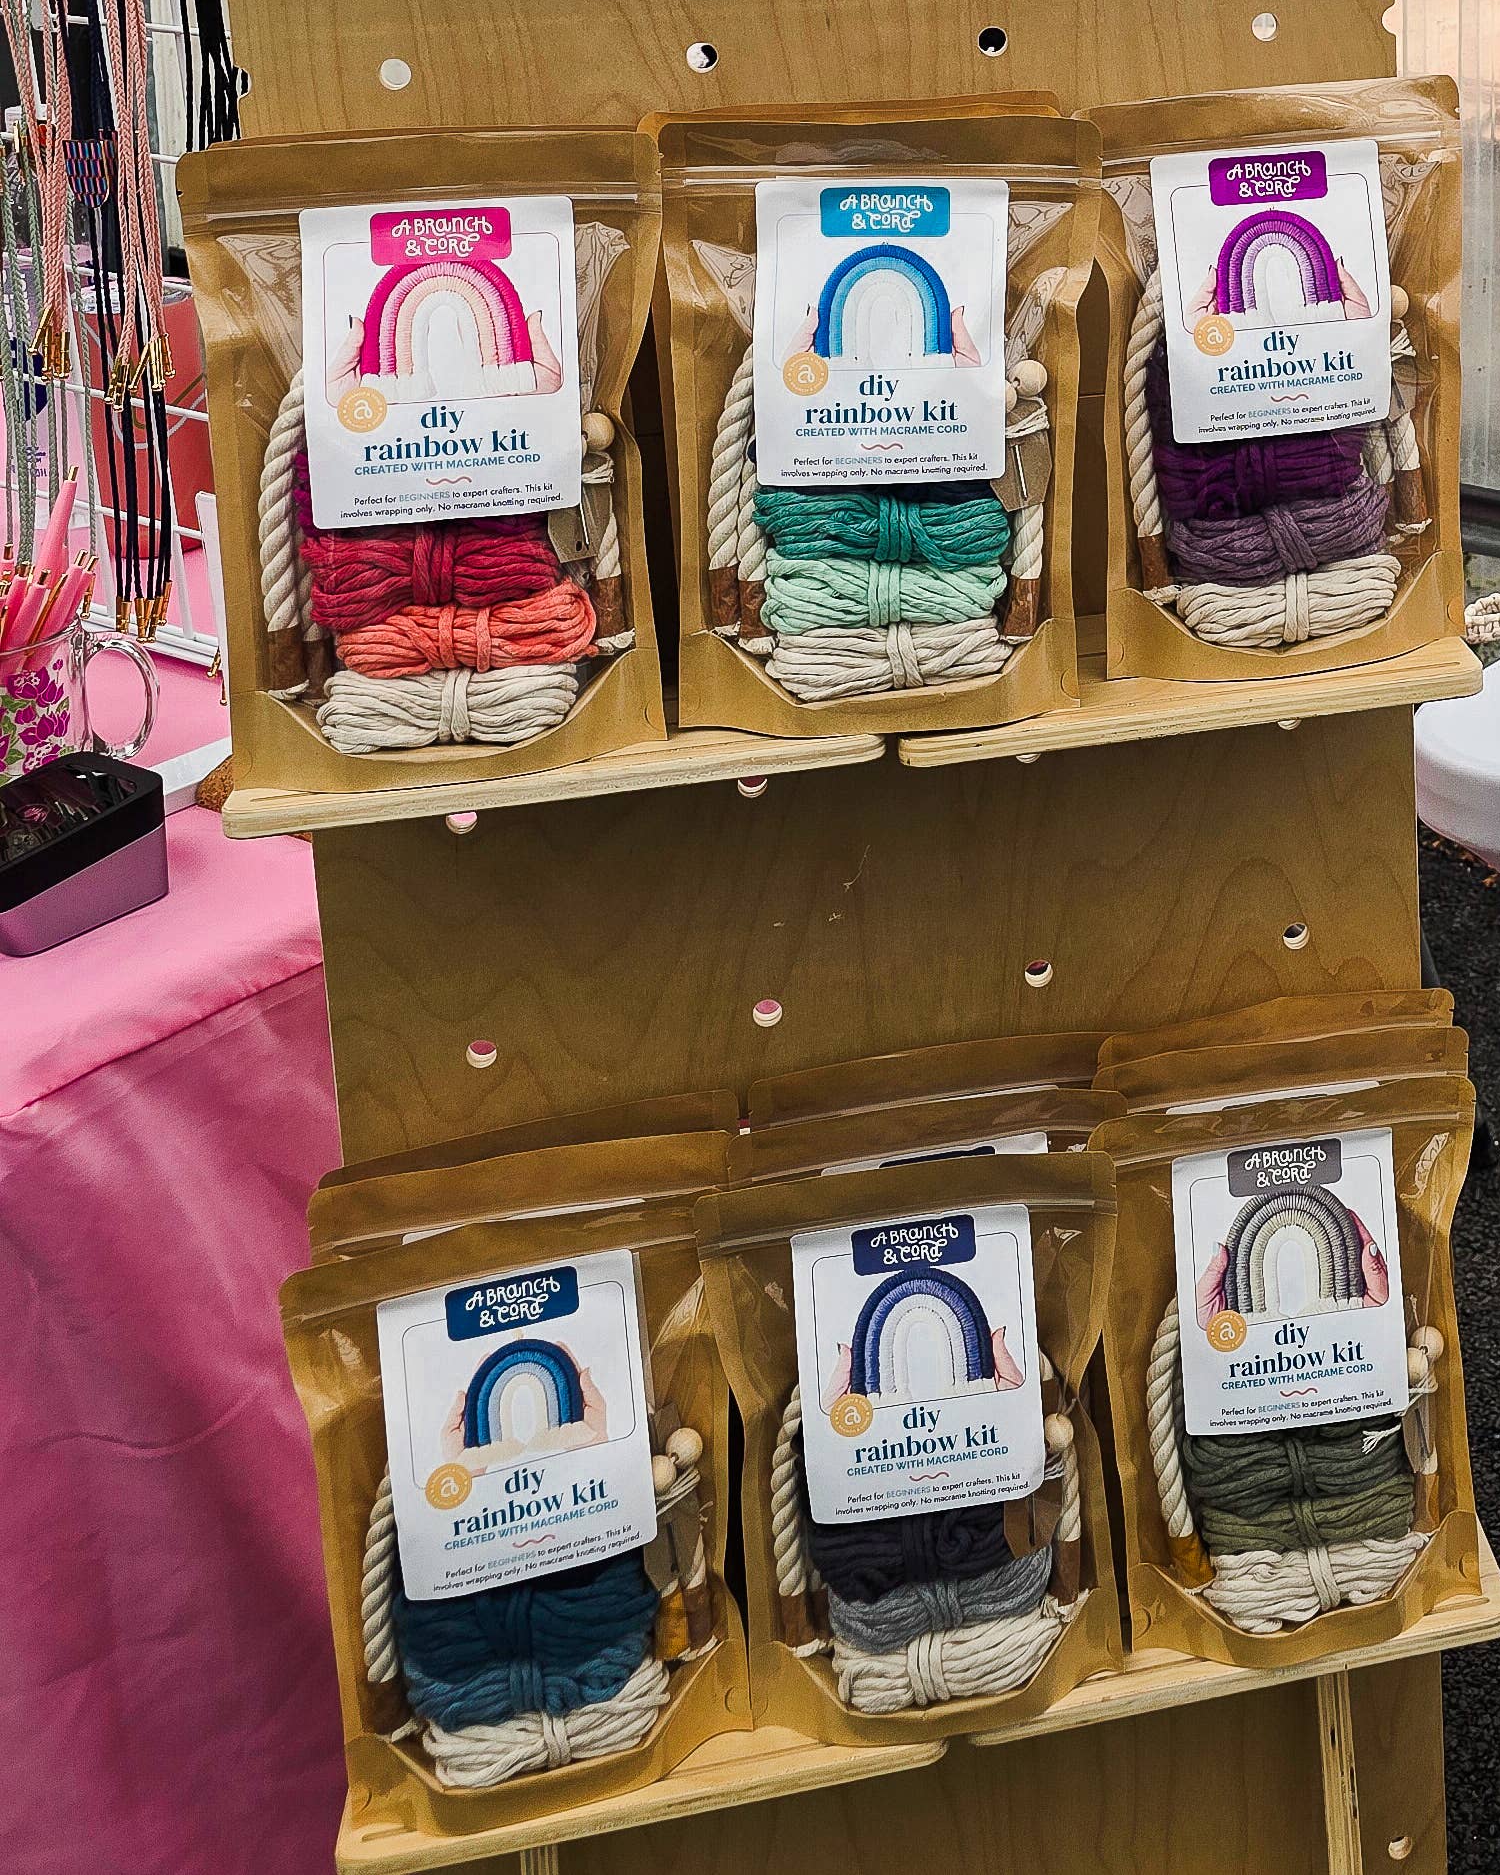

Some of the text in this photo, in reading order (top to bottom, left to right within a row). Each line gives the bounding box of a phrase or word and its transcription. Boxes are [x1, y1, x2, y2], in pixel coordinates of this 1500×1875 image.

[1239, 183, 1253, 197] &
[852, 214, 866, 230] &
[405, 240, 422, 257] &
[1263, 331, 1299, 355] diy
[1217, 351, 1354, 382] rainbow kit
[859, 375, 899, 401] diy
[1210, 372, 1362, 395] CREATED WITH MACRAME CORD
[420, 406, 464, 433] diy
[805, 400, 958, 424] rainbow kit
[796, 425, 967, 437] CREATED WITH MACRAME CORD
[364, 428, 530, 462] rainbow kit
[354, 453, 541, 476] CREATED WITH MACRAME CORD
[354, 497, 382, 506] Perfect
[385, 495, 397, 503] for
[399, 491, 450, 502] BEGINNERS
[463, 489, 488, 499] expert
[490, 485, 522, 495] crafters.
[525, 484, 541, 492] This
[543, 483, 553, 491] kit
[341, 495, 564, 519] involves wrapping only. No macrame knotting required.
[1256, 1173, 1271, 1187] &
[883, 1249, 898, 1264] &
[479, 1310, 495, 1327] &
[1274, 1323, 1310, 1348] diy
[1229, 1341, 1365, 1378] rainbow kit
[1221, 1364, 1374, 1390] CREATED WITH MACRAME CORD
[902, 1406, 941, 1433] diy
[855, 1425, 999, 1464] rainbow kit
[847, 1446, 1009, 1477] CREATED WITH MACRAME CORD
[504, 1467, 546, 1495] diy
[452, 1479, 609, 1537] rainbow kit
[444, 1499, 619, 1551] CREATED WITH MACRAME CORD
